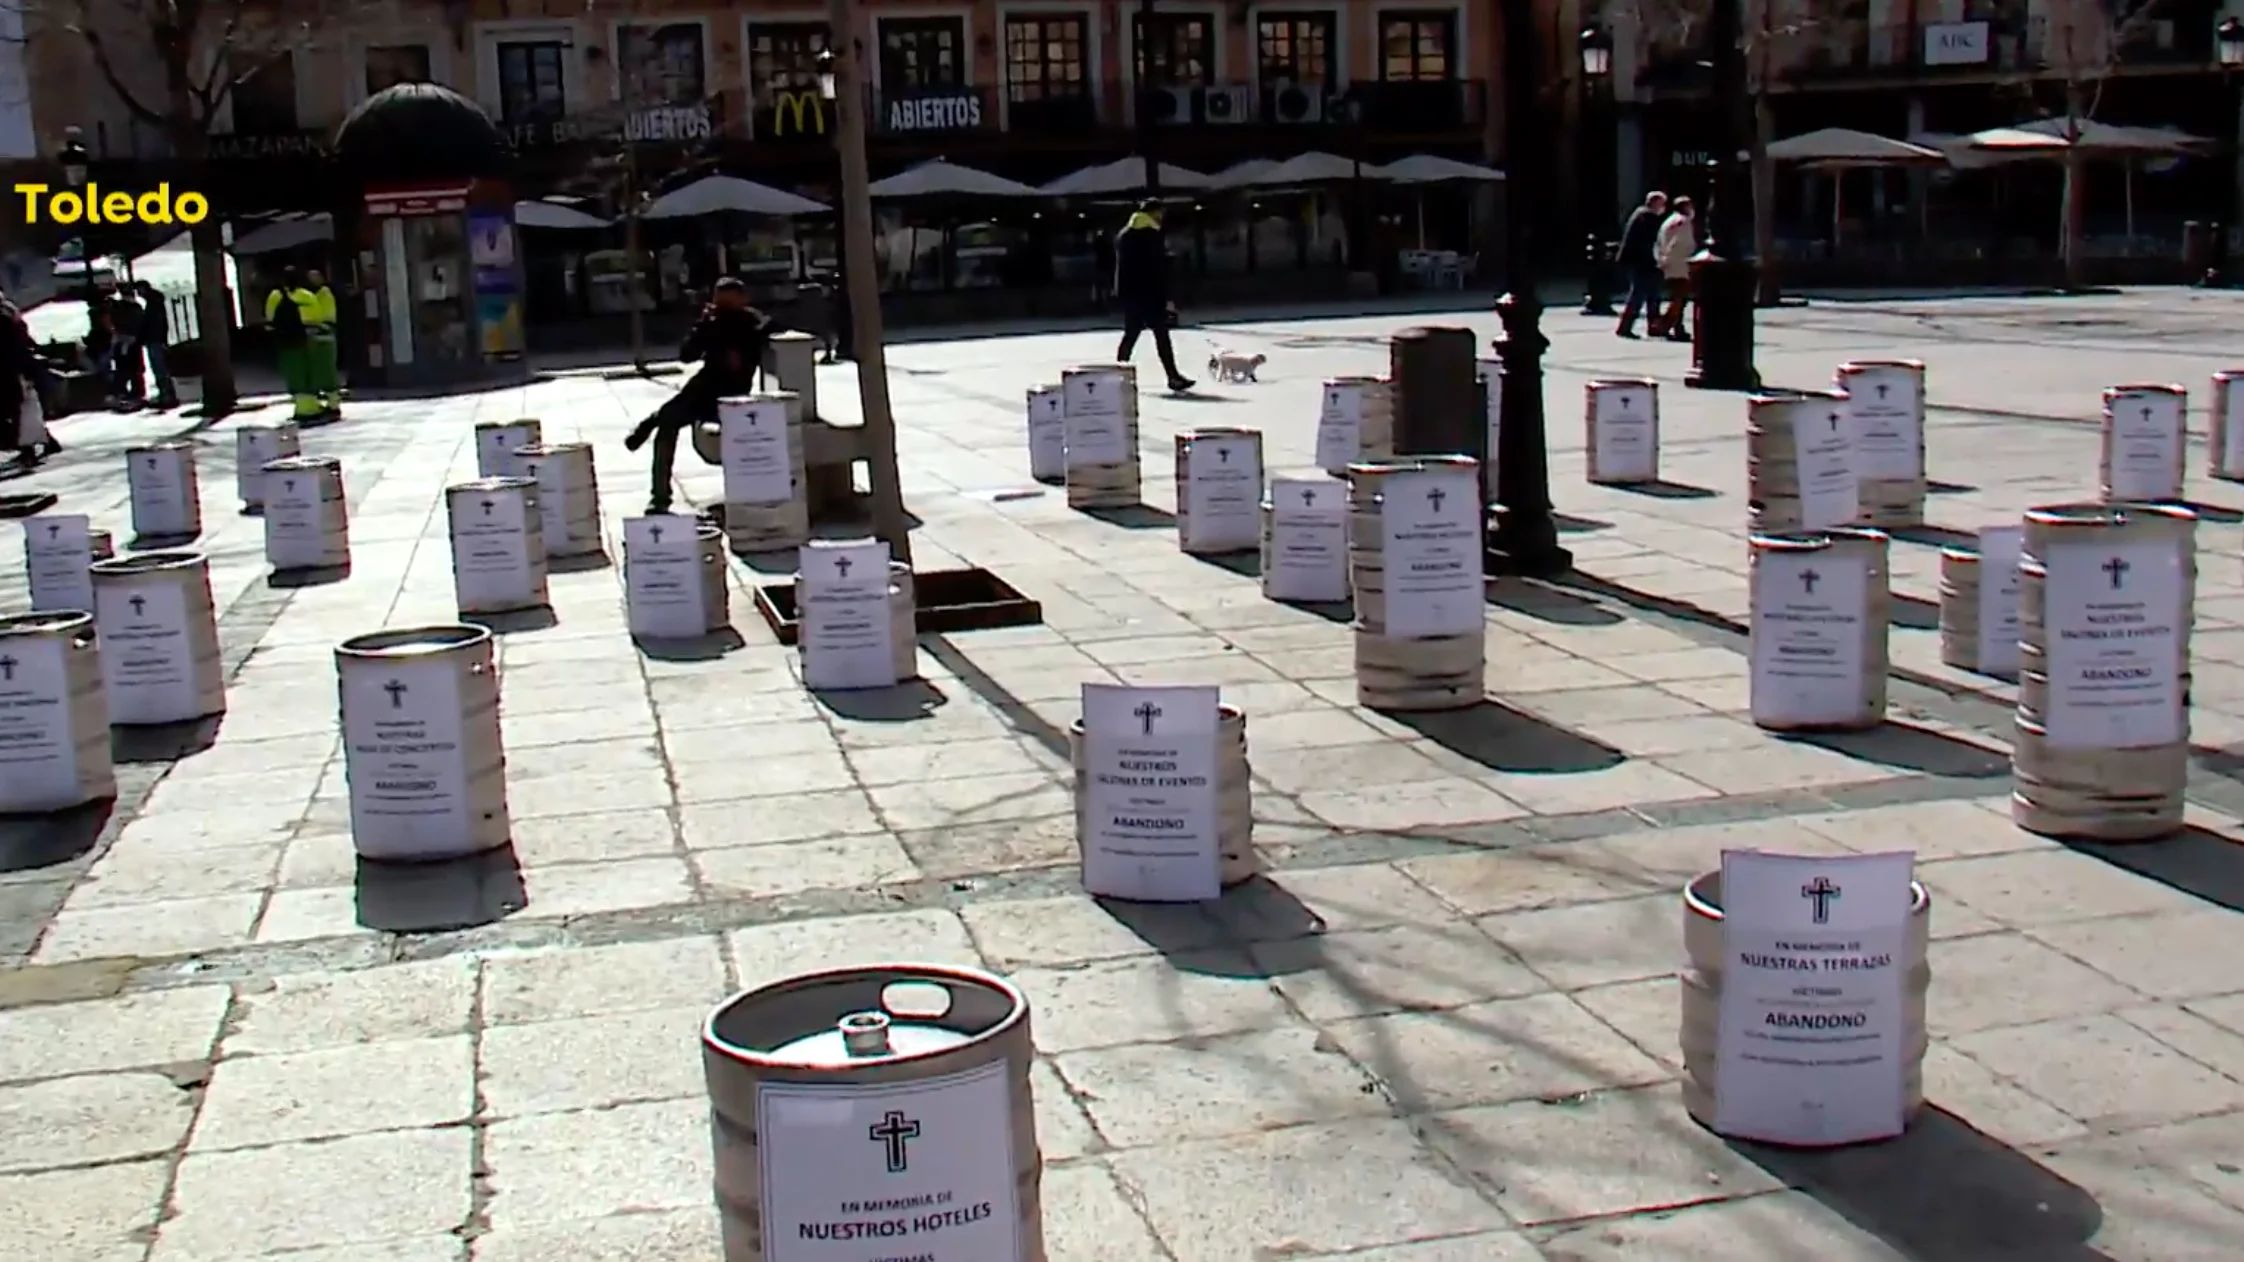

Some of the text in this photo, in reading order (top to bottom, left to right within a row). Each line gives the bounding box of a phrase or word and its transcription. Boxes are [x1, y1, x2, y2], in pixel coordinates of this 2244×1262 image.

[890, 96, 980, 131] ABIERTOS
[1741, 953, 1892, 971] NUESTRAS TERRAZAS
[1765, 1012, 1867, 1029] ABANDONO
[841, 1190, 952, 1214] EN MEMORIA DE
[799, 1201, 991, 1240] NUESTROS HOTELES
